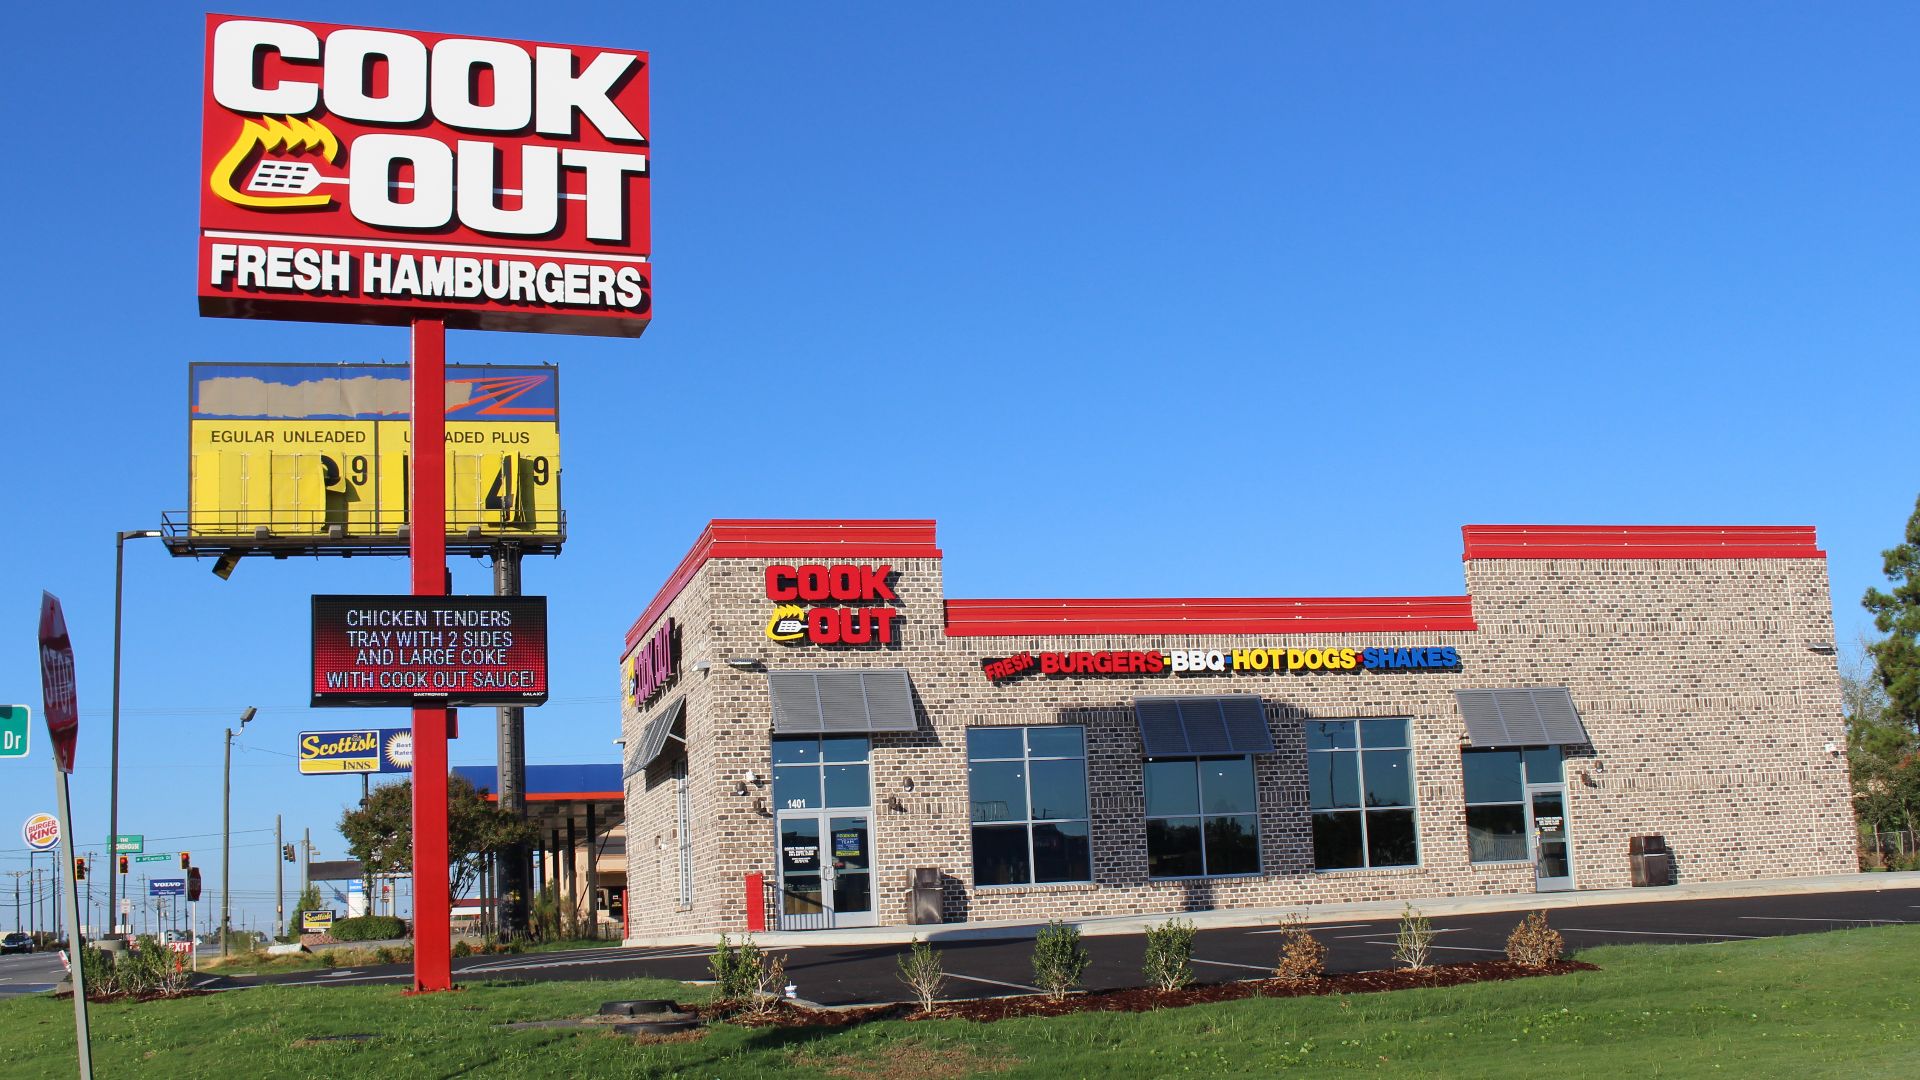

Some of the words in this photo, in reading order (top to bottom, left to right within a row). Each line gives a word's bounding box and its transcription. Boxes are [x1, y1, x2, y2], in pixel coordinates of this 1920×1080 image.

[212, 20, 645, 141] COOK
[349, 134, 646, 241] OUT
[210, 243, 350, 290] FRESH
[363, 252, 642, 307] HAMBURGERS
[283, 430, 366, 443] UNLEADED
[492, 431, 530, 444] PLUS
[351, 455, 368, 486] 9
[533, 455, 550, 486] 9
[765, 564, 897, 601] COOK
[347, 609, 427, 626] CHICKEN
[431, 610, 512, 627] TENDERS
[808, 607, 897, 644] OUT
[346, 630, 392, 647] TRAY
[396, 630, 442, 647] WITH
[448, 630, 459, 647] 2
[463, 630, 512, 647] SIDES
[356, 648, 394, 665] AND
[400, 648, 455, 665] LARGE
[461, 648, 508, 665] COKE
[984, 651, 1035, 682] FRESH
[1039, 650, 1165, 674] BURGERS
[1171, 649, 1226, 671] BBQ
[1231, 648, 1286, 670] HOT
[1287, 647, 1357, 670] DOGS
[1363, 647, 1458, 669] SHAKES
[326, 671, 374, 688] WITH
[380, 671, 428, 688] COOK
[433, 671, 469, 688] OUT
[473, 671, 534, 688] SAUCE!
[4, 730, 22, 750] Dr
[301, 732, 377, 759] Scottish
[787, 799, 806, 809] 1401
[28, 819, 57, 834] BURGER
[29, 825, 58, 842] KING
[168, 942, 191, 952] EXIT
